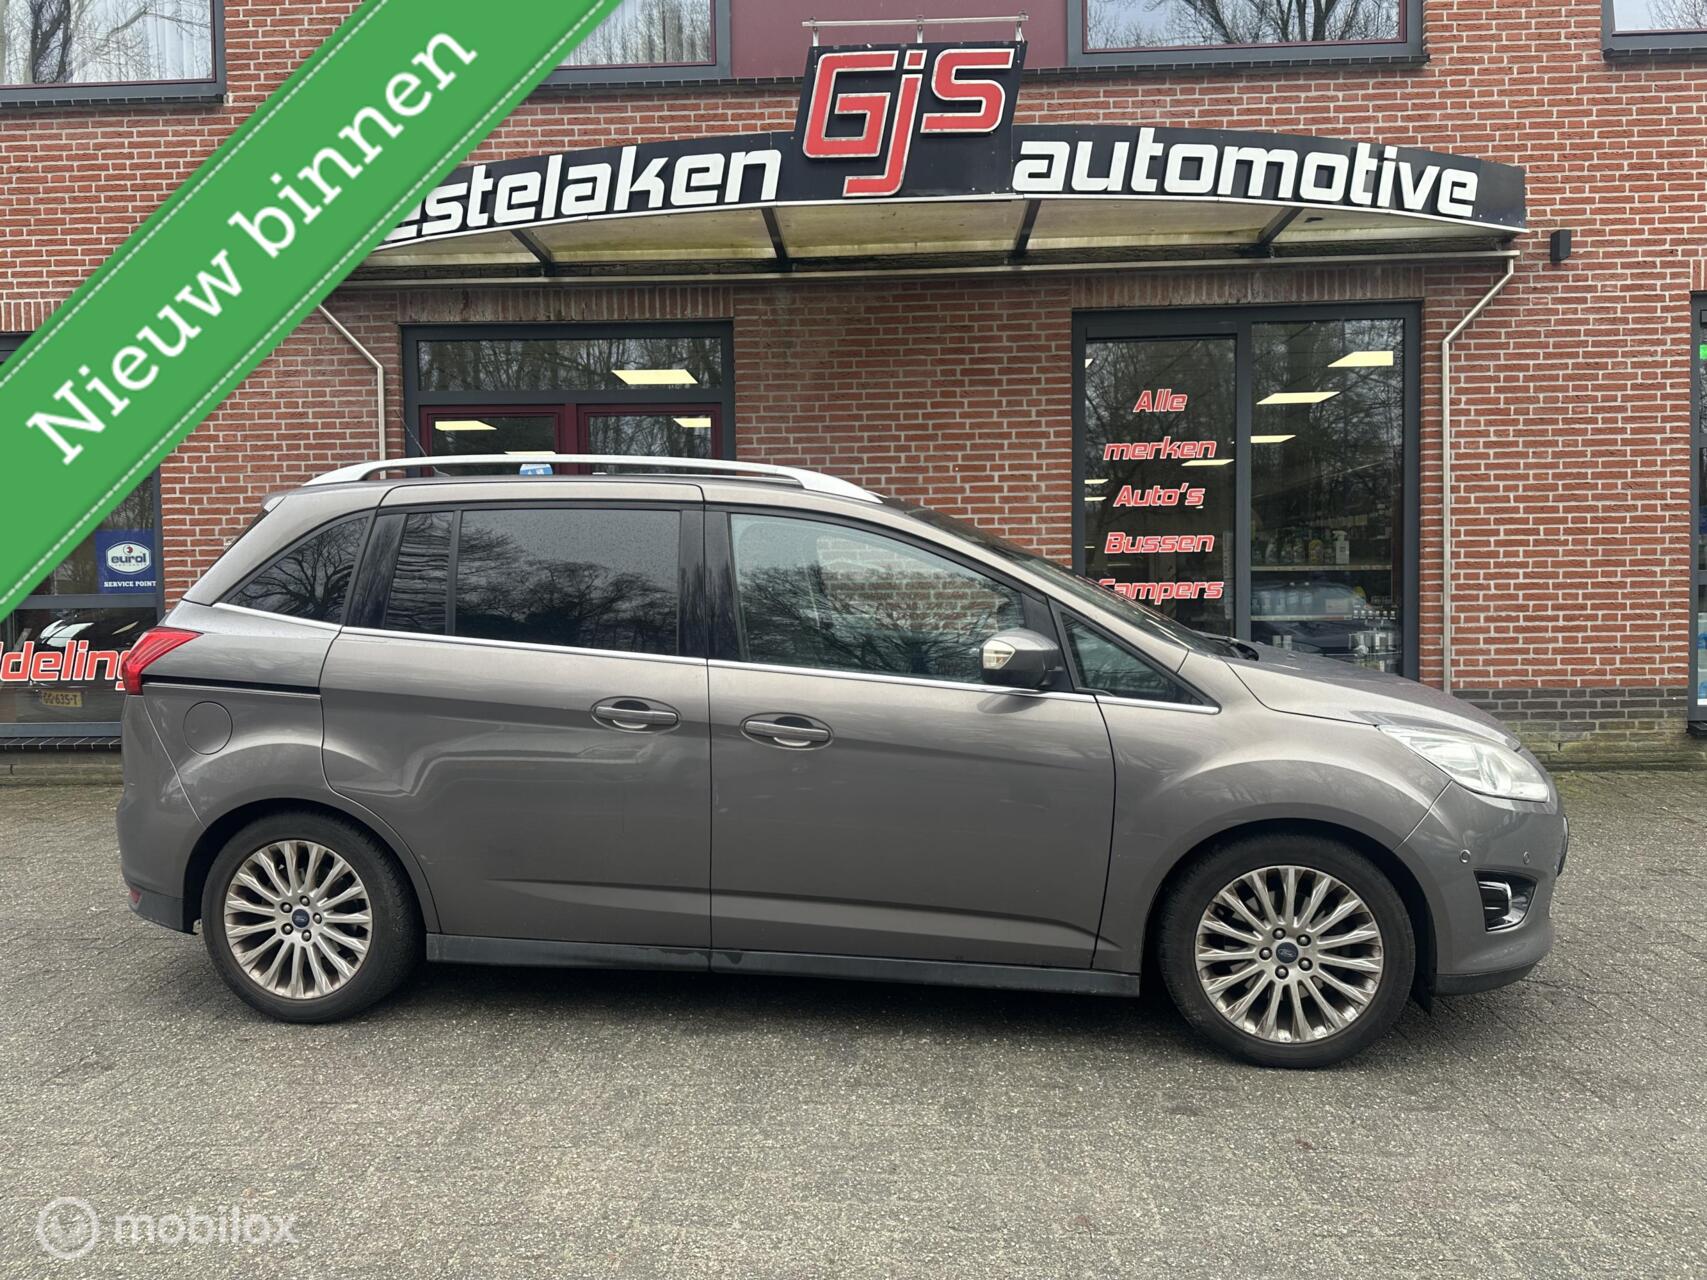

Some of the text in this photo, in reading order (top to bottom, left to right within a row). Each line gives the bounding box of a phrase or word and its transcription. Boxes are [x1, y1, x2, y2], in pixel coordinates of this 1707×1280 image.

[1012, 127, 1479, 217] automotive
[1133, 389, 1188, 413] Alle
[1103, 436, 1217, 461] merken
[1113, 482, 1206, 507] Auto's
[1104, 532, 1215, 554] Bussen
[111, 553, 147, 564] eurol
